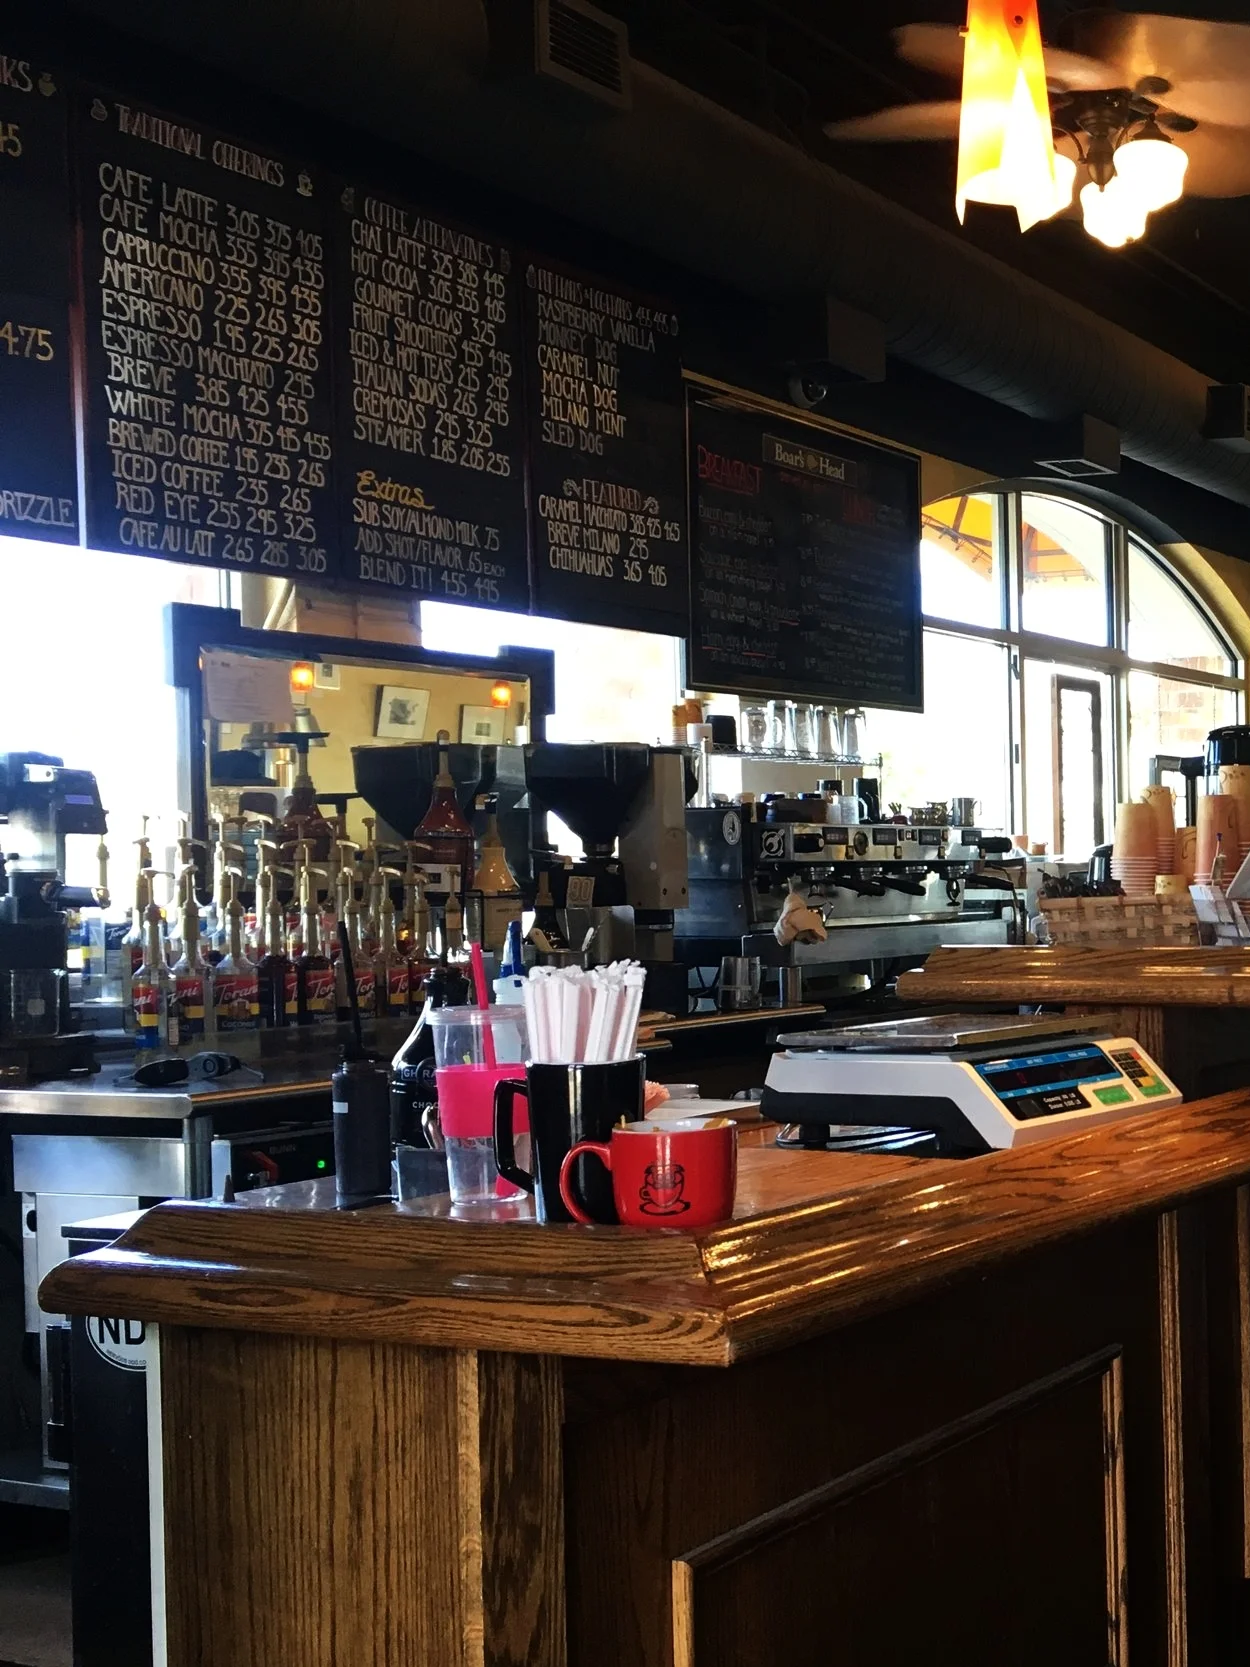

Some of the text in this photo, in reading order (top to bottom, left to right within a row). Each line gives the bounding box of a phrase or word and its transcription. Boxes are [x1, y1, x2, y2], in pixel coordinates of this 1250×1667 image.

[115, 103, 206, 160] TRADITIONAL
[99, 163, 153, 204] CAFE
[163, 182, 218, 226] LATTE
[100, 194, 148, 233] CAFE
[160, 212, 221, 257] MOCHA
[352, 219, 382, 253] CHAI
[387, 232, 427, 270] LATTE
[102, 228, 215, 284] CAPPUCCINO
[351, 247, 377, 277] HOT
[382, 259, 421, 295] COCOA
[99, 257, 203, 311] AMERICANO
[354, 276, 414, 318] GOURMET
[419, 300, 462, 335] COCOAS
[102, 288, 201, 342] ESPRESSO
[353, 302, 389, 338] FRUIT
[394, 317, 457, 359] SMOOTHIES
[537, 293, 605, 337] RASPBERRY
[610, 318, 656, 353] VANILLA
[101, 322, 193, 368] ESPRESSO
[198, 346, 274, 388] MACCHIATO
[349, 328, 379, 360] ICED
[383, 340, 394, 365] &
[396, 344, 420, 374] HOT
[421, 350, 453, 384] TEAS
[538, 319, 618, 364] MONKEY DOG
[107, 351, 176, 395] BREVE
[352, 357, 403, 397] ITALIAN
[408, 374, 448, 409] SODAS
[538, 344, 620, 388] CARAMEL NUT
[104, 385, 175, 427] WHITE
[183, 403, 244, 442] MOCHA
[353, 387, 425, 429] CREMOSAS
[541, 369, 617, 412] MOCHA DOG
[354, 415, 425, 455] STEAMER
[541, 395, 627, 438] MILANO MINT
[542, 420, 603, 456] SLED DOG
[107, 418, 176, 456] BREWED
[180, 434, 230, 468] COFFEE
[775, 443, 846, 481] Boar's Head
[112, 450, 157, 483] ICED
[162, 461, 224, 497] COFFEE
[357, 470, 435, 510] Extras
[583, 478, 641, 511] FEATURED
[116, 481, 155, 514] RED
[164, 491, 200, 524] EYE
[353, 498, 379, 526] SUB
[382, 504, 454, 541] SOY/ALMOND
[455, 521, 481, 549] MILK
[539, 494, 582, 523] CARAMEL
[583, 503, 627, 531] MACCHIATO
[120, 518, 158, 549] CAFE
[160, 525, 181, 552] AU
[185, 530, 215, 557] LAIT
[355, 527, 383, 554] ADD
[385, 533, 464, 571] SHOT/FLAVOR
[484, 562, 505, 577] EACH
[548, 521, 580, 547] BREVE
[583, 528, 620, 554] MILANO
[360, 555, 405, 586] BLEND
[550, 546, 613, 577] CHIHUAHUAS
